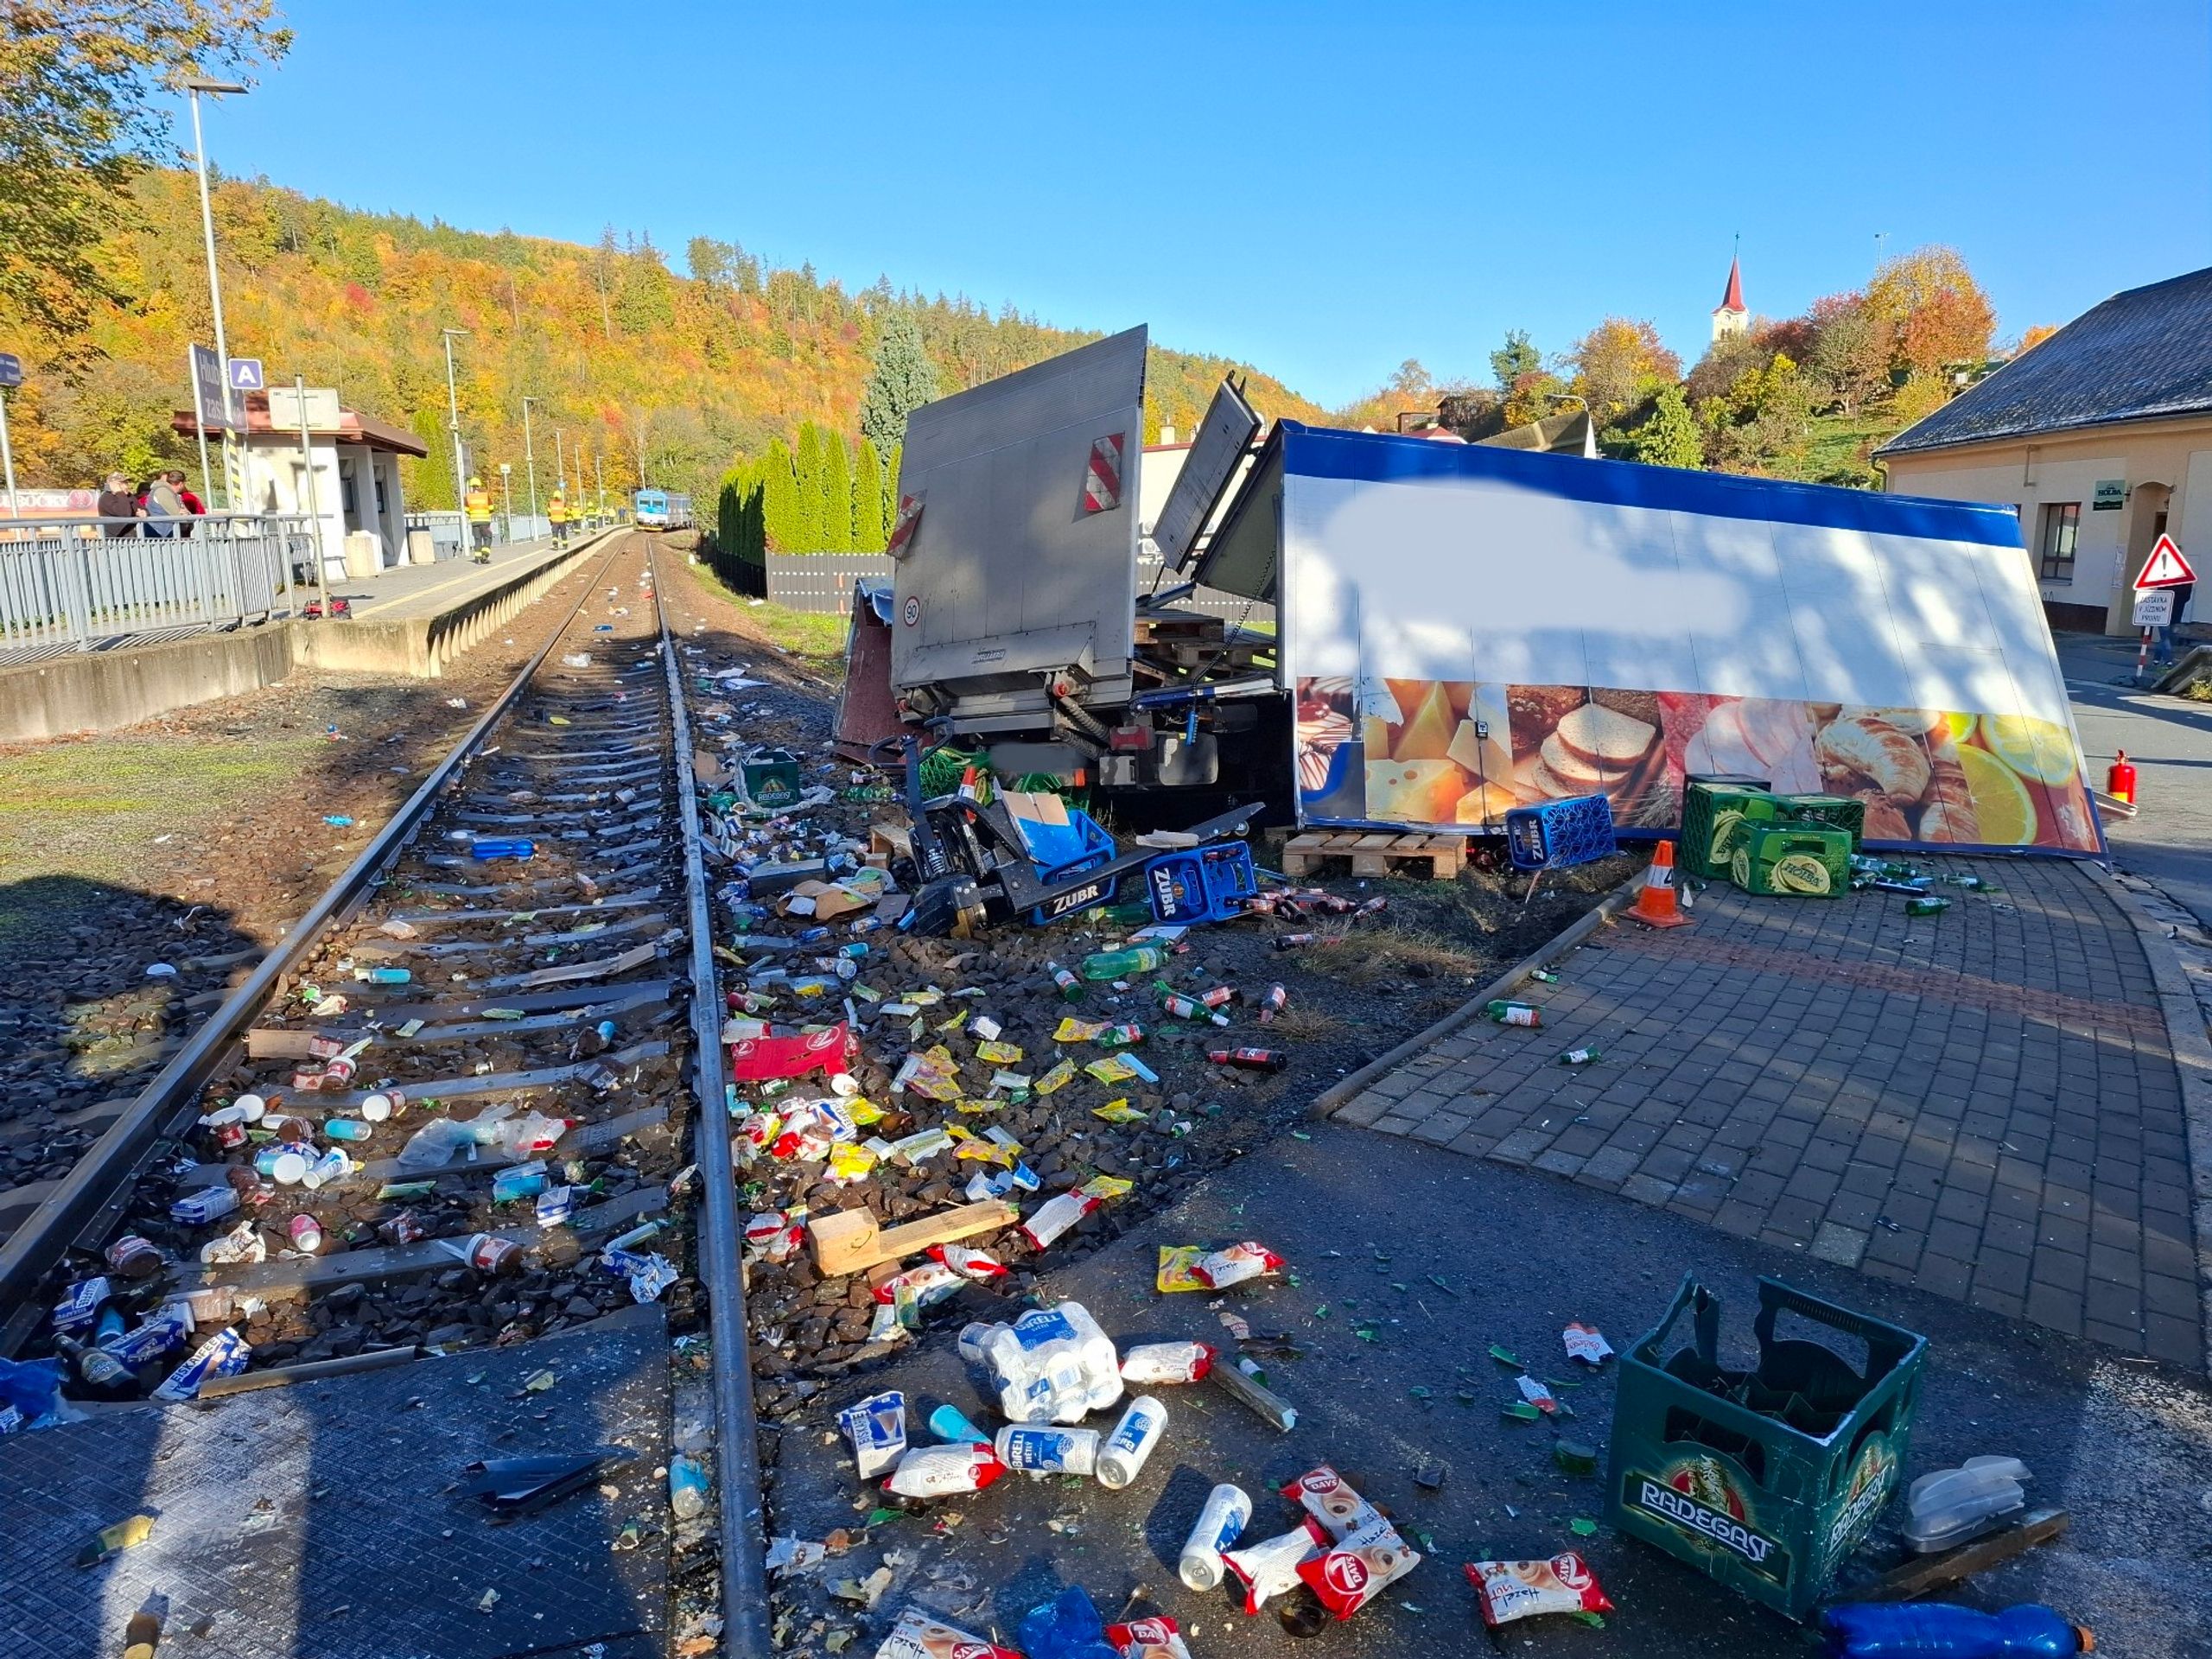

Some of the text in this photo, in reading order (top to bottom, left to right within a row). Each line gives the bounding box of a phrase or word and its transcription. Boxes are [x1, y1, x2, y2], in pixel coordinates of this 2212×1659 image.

[238, 365, 257, 384] A
[906, 606, 917, 619] 90
[1529, 819, 1544, 861] ZUBR
[1664, 868, 1675, 887] 4
[1053, 884, 1099, 914] ZUBR
[1154, 867, 1177, 917] ZUBR
[1312, 1478, 1338, 1490] DAYS
[1641, 1480, 1773, 1562] RADEGAST
[1345, 1555, 1363, 1584] DAYS
[1559, 1556, 1569, 1584] DAYS
[1501, 1586, 1541, 1608] Hazel
[889, 1635, 926, 1659] Hazel
